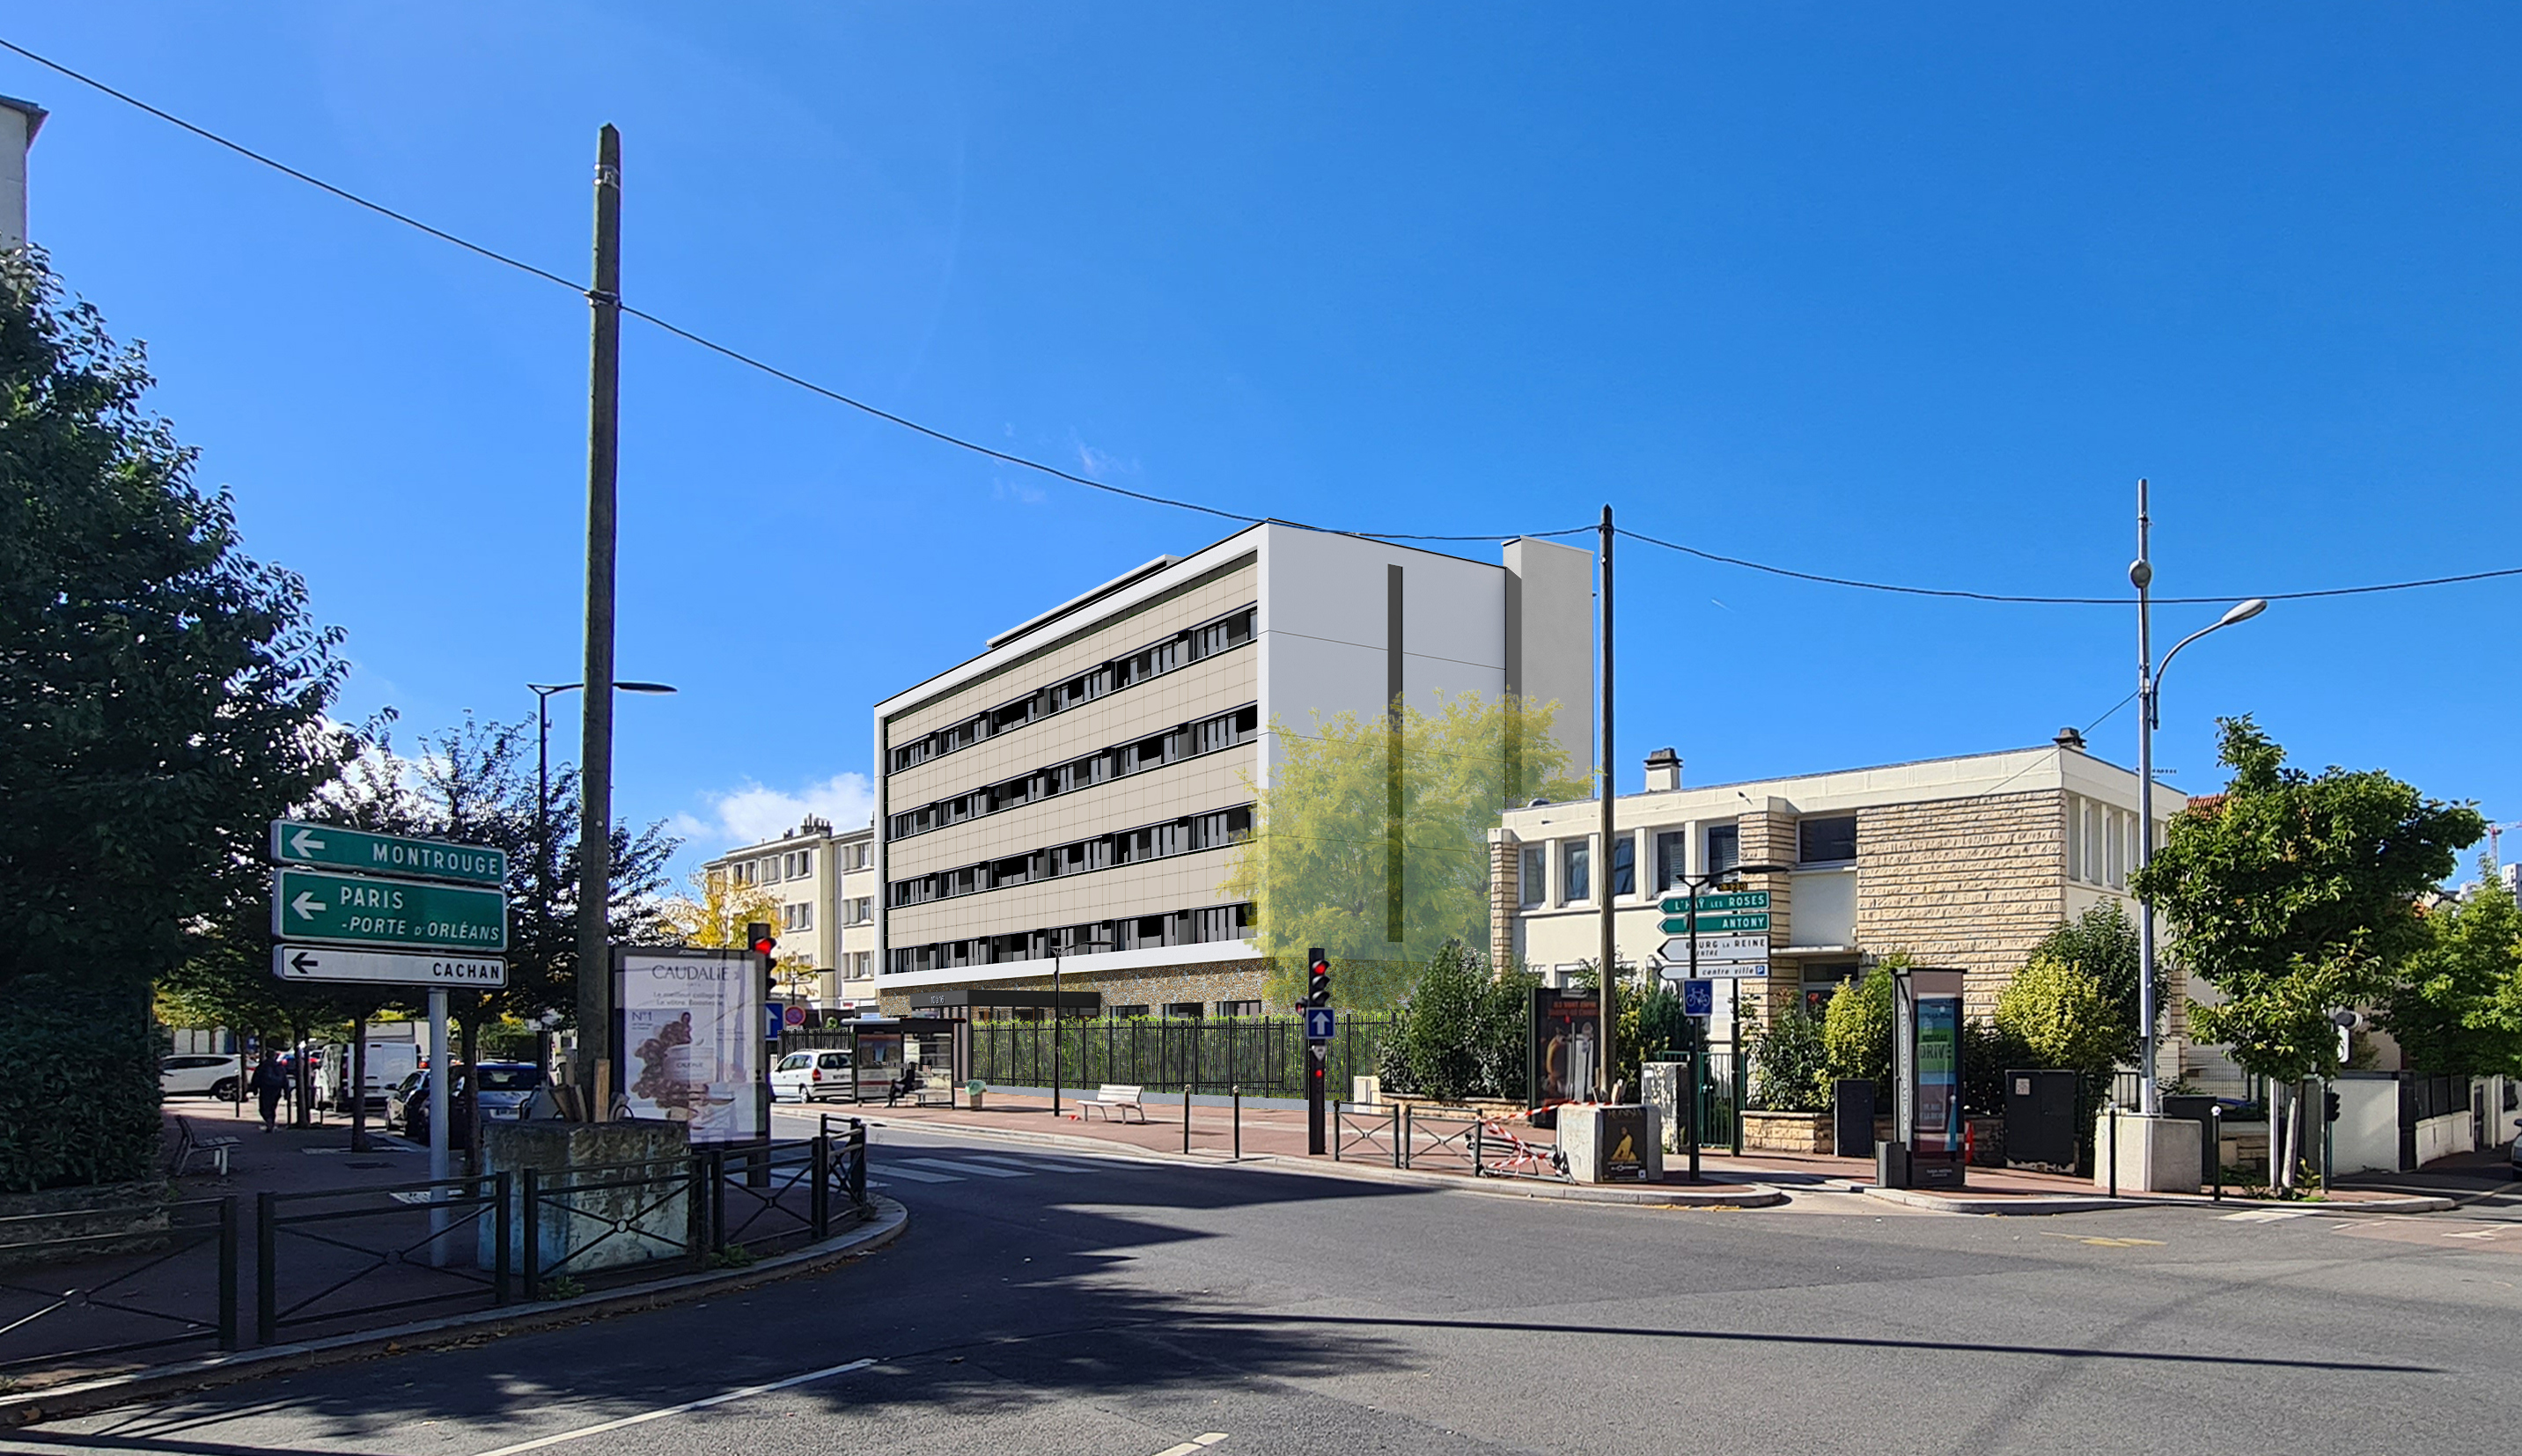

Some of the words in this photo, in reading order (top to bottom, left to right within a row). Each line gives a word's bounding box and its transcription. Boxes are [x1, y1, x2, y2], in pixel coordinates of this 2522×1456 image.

[372, 842, 499, 876] MONTROUGE
[341, 886, 404, 909] PARIS
[1729, 895, 1765, 907] ROSES
[1722, 917, 1765, 929] ANTONY
[1686, 940, 1718, 950] BURG
[1734, 939, 1765, 948] REINE
[432, 962, 500, 980] CACHAN
[1702, 967, 1730, 976] centre
